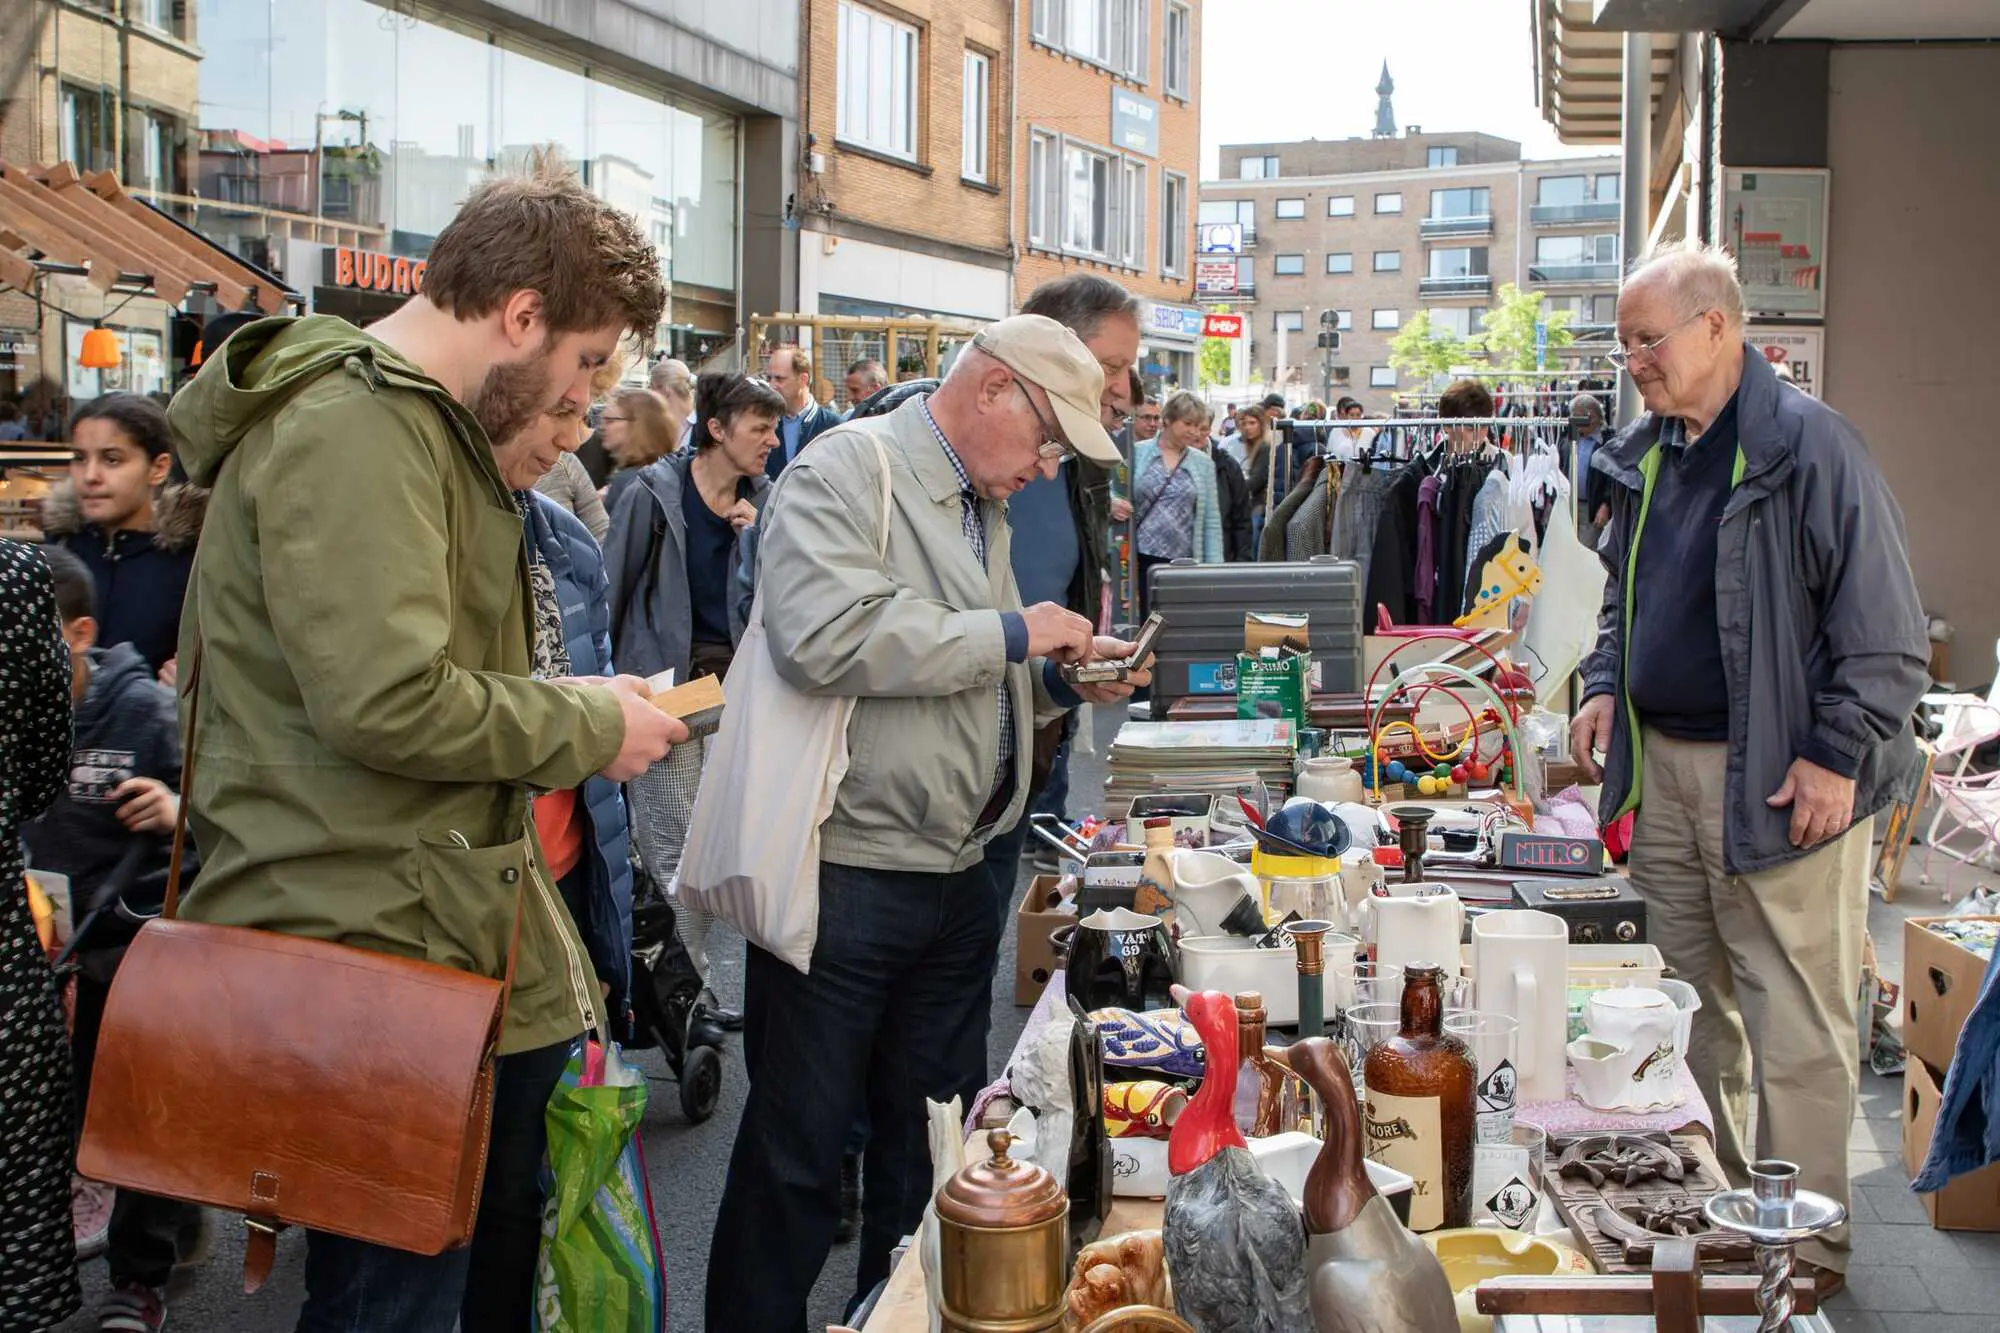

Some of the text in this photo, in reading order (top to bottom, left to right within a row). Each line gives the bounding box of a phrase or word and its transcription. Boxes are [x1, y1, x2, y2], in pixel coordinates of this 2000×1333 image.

[1155, 305, 1184, 331] SHOP
[1114, 932, 1147, 945] VAT
[1121, 944, 1141, 957] 69
[1367, 1122, 1401, 1137] MORE
